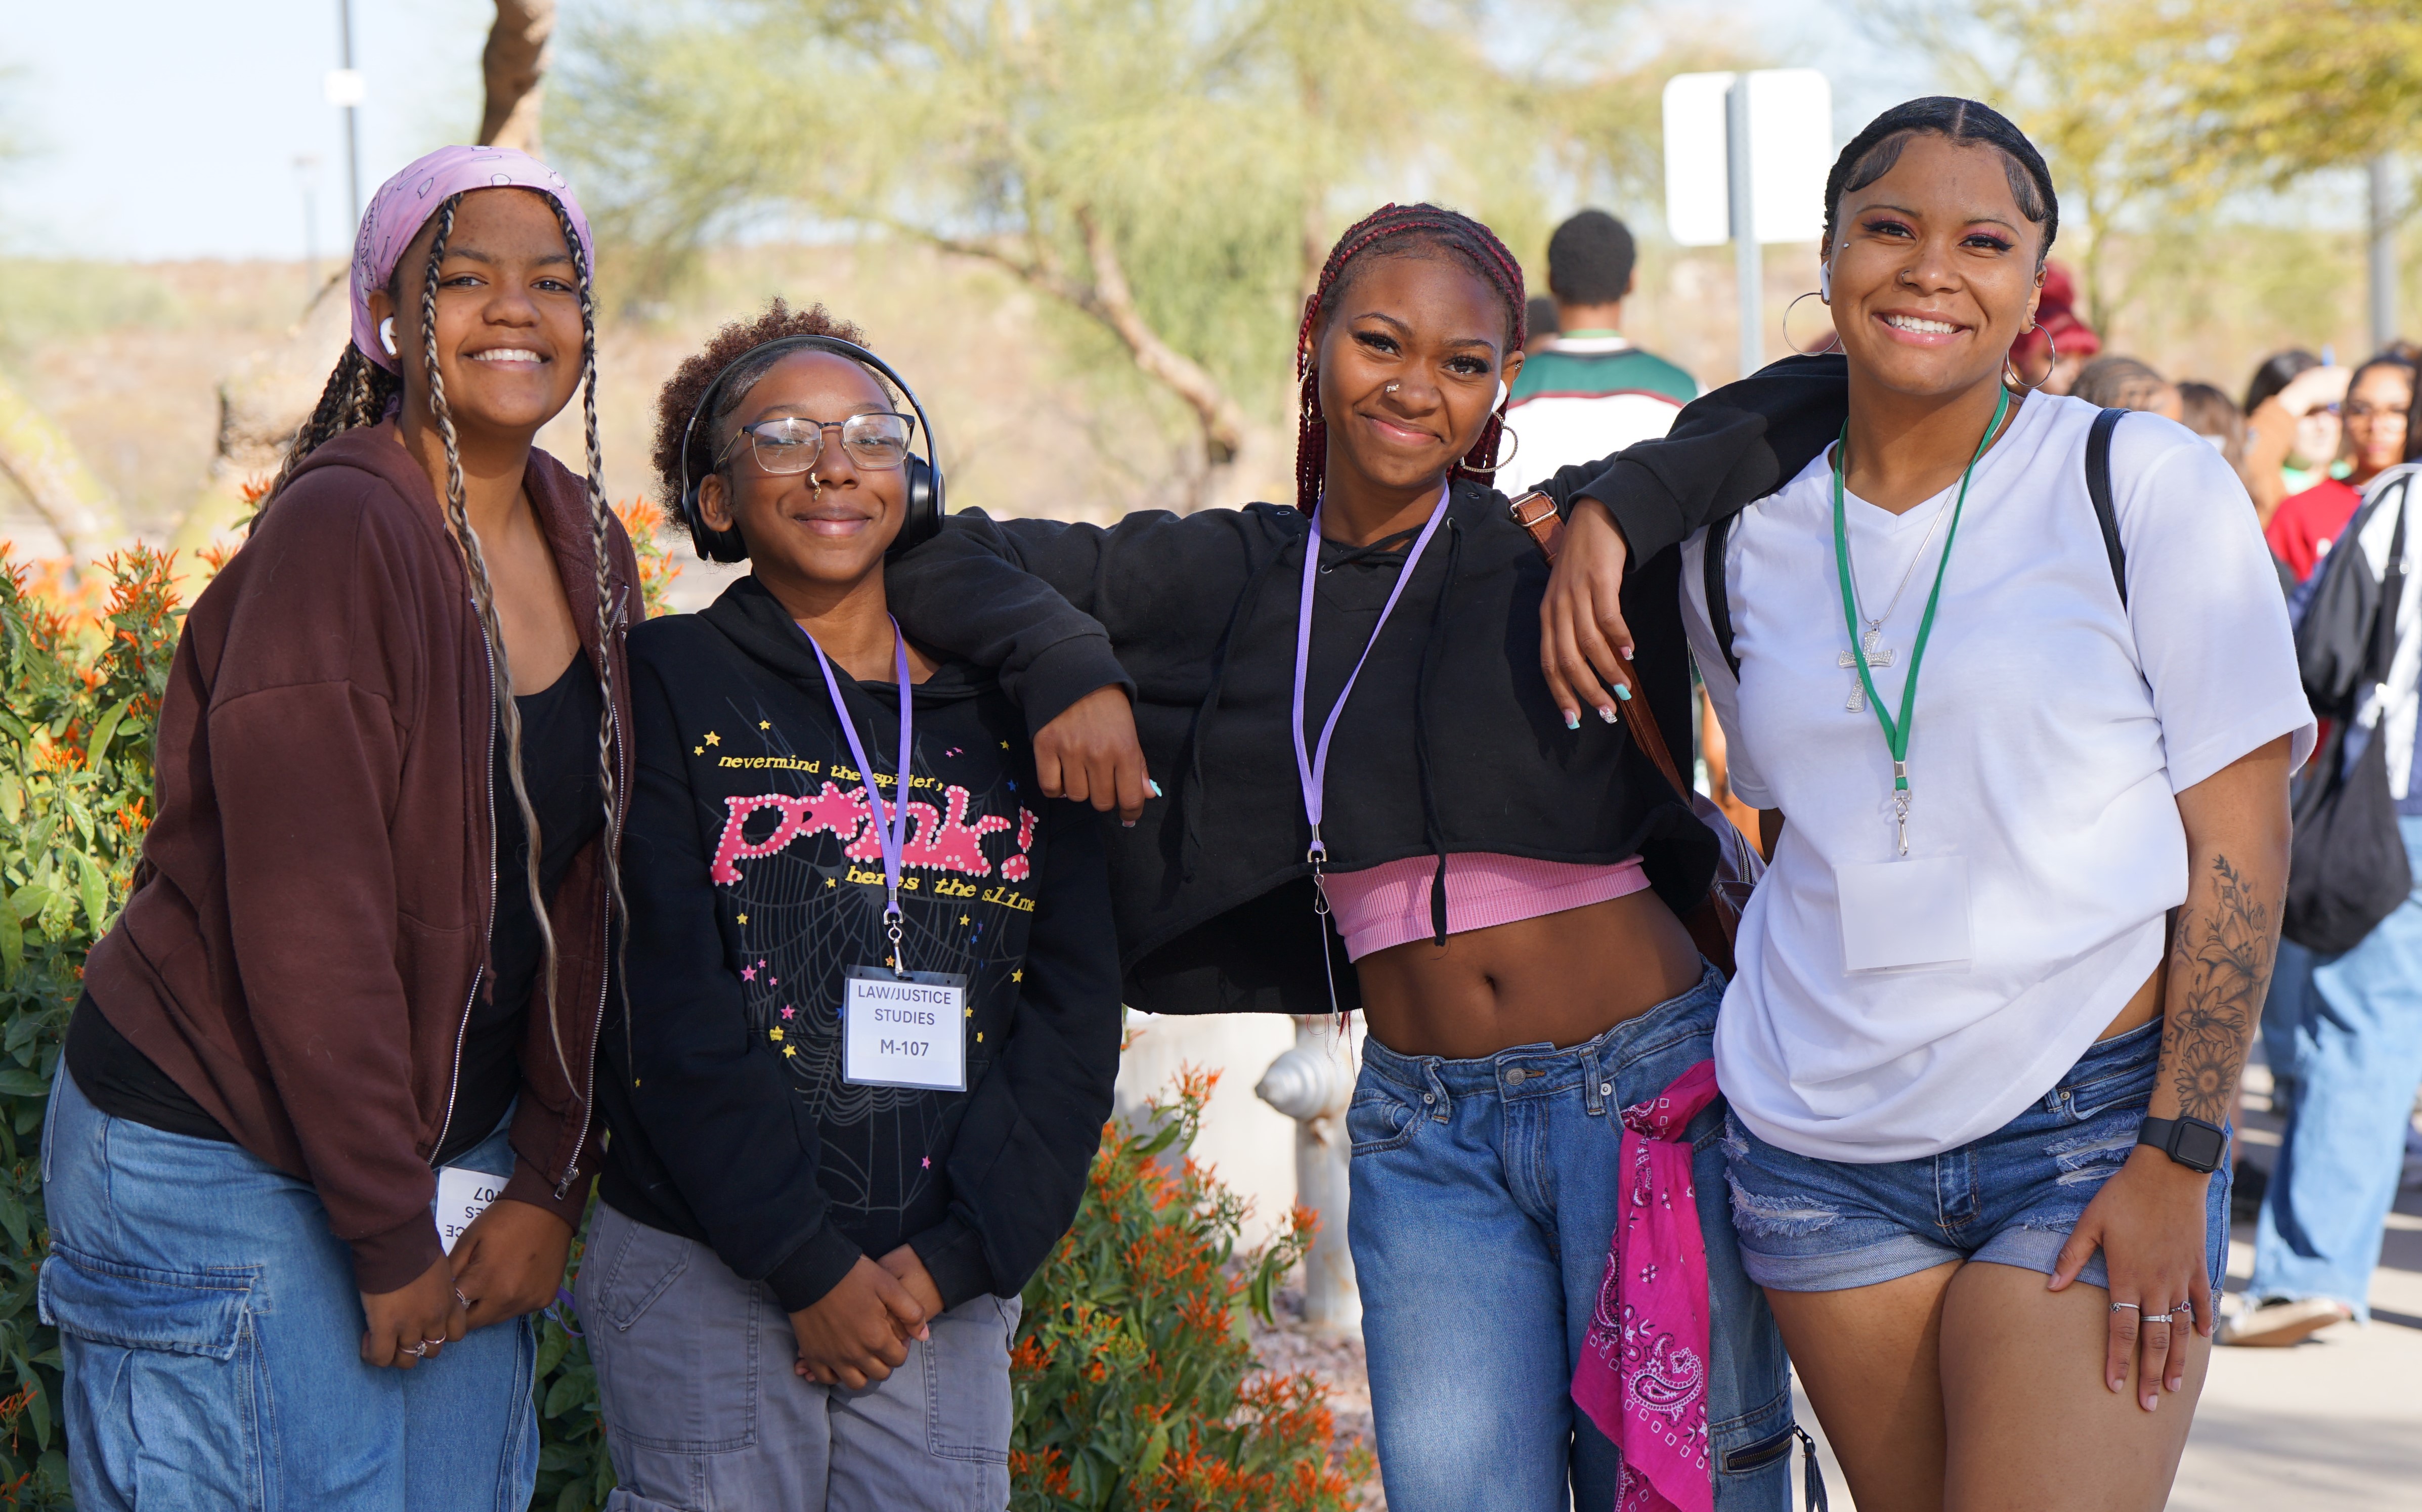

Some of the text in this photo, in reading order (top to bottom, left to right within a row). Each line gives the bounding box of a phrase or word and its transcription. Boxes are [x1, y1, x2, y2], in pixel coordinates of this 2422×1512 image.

[718, 754, 820, 773] nevermind
[831, 764, 861, 781] the
[934, 878, 977, 897] the
[981, 886, 1035, 912] slime
[857, 985, 952, 1005] LAW/JUSTICE
[874, 1009, 935, 1025] STUDIES
[880, 1039, 929, 1056] M-107
